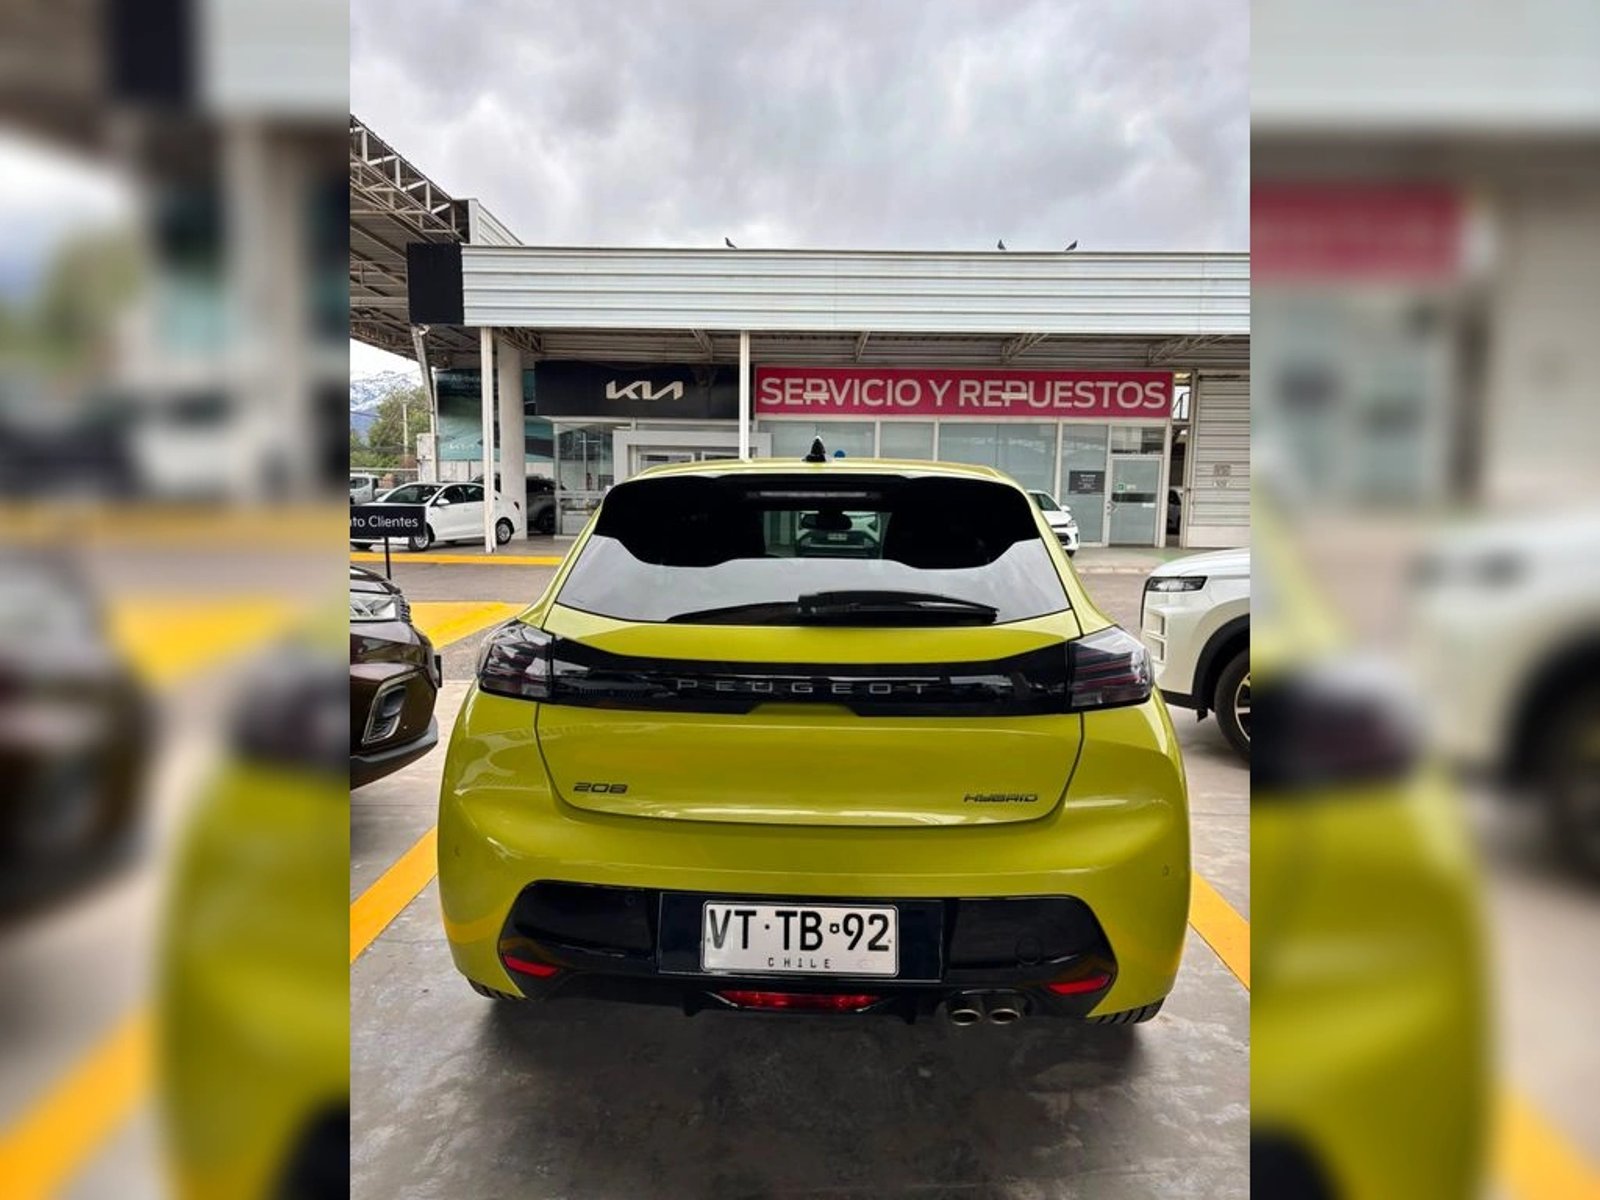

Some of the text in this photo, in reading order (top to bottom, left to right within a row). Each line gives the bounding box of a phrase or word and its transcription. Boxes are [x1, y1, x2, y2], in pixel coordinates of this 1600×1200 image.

[761, 377, 1166, 409] SERVICIO Y REPUESTOS
[350, 515, 419, 528] to Clientes
[677, 679, 929, 695] PEUGEOT
[574, 782, 628, 794] 208
[963, 793, 1038, 803] HYBRID
[767, 957, 832, 969] CHILE
